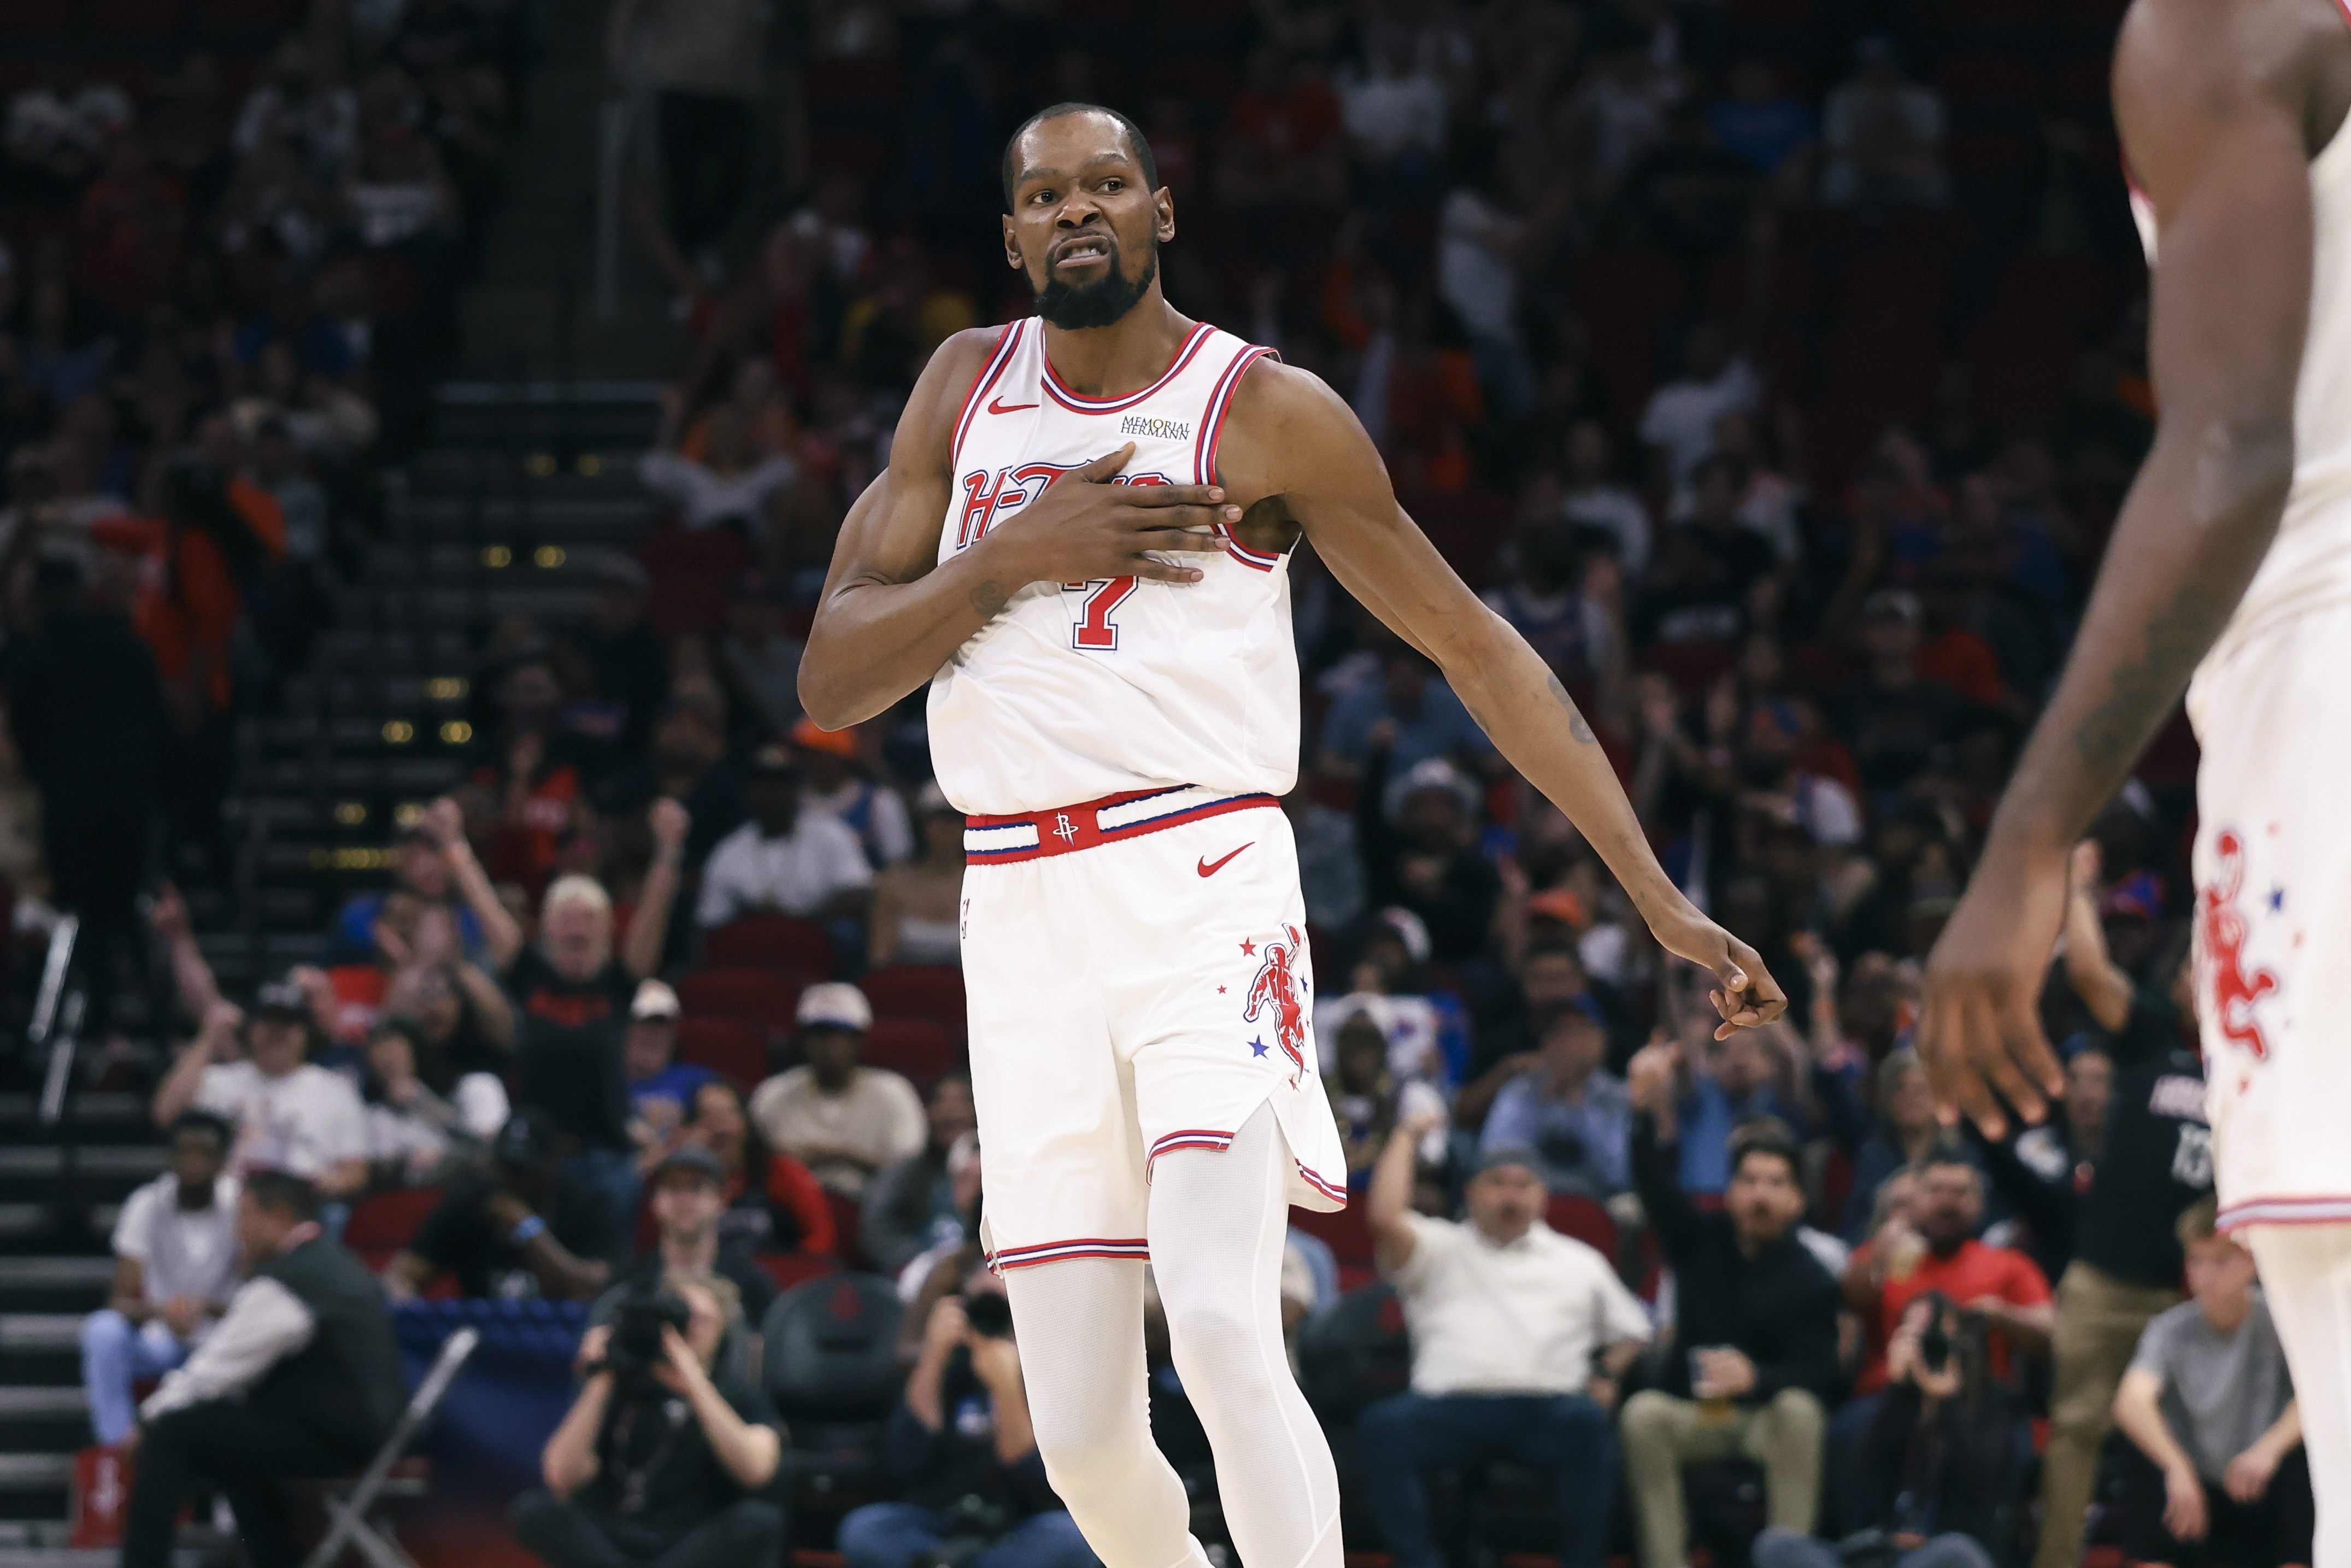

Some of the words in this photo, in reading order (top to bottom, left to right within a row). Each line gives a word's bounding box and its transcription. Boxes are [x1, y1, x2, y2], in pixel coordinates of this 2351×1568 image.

[1120, 423, 1190, 441] HERMANN
[1121, 415, 1190, 432] MEMORIAL
[1061, 575, 1139, 651] 7
